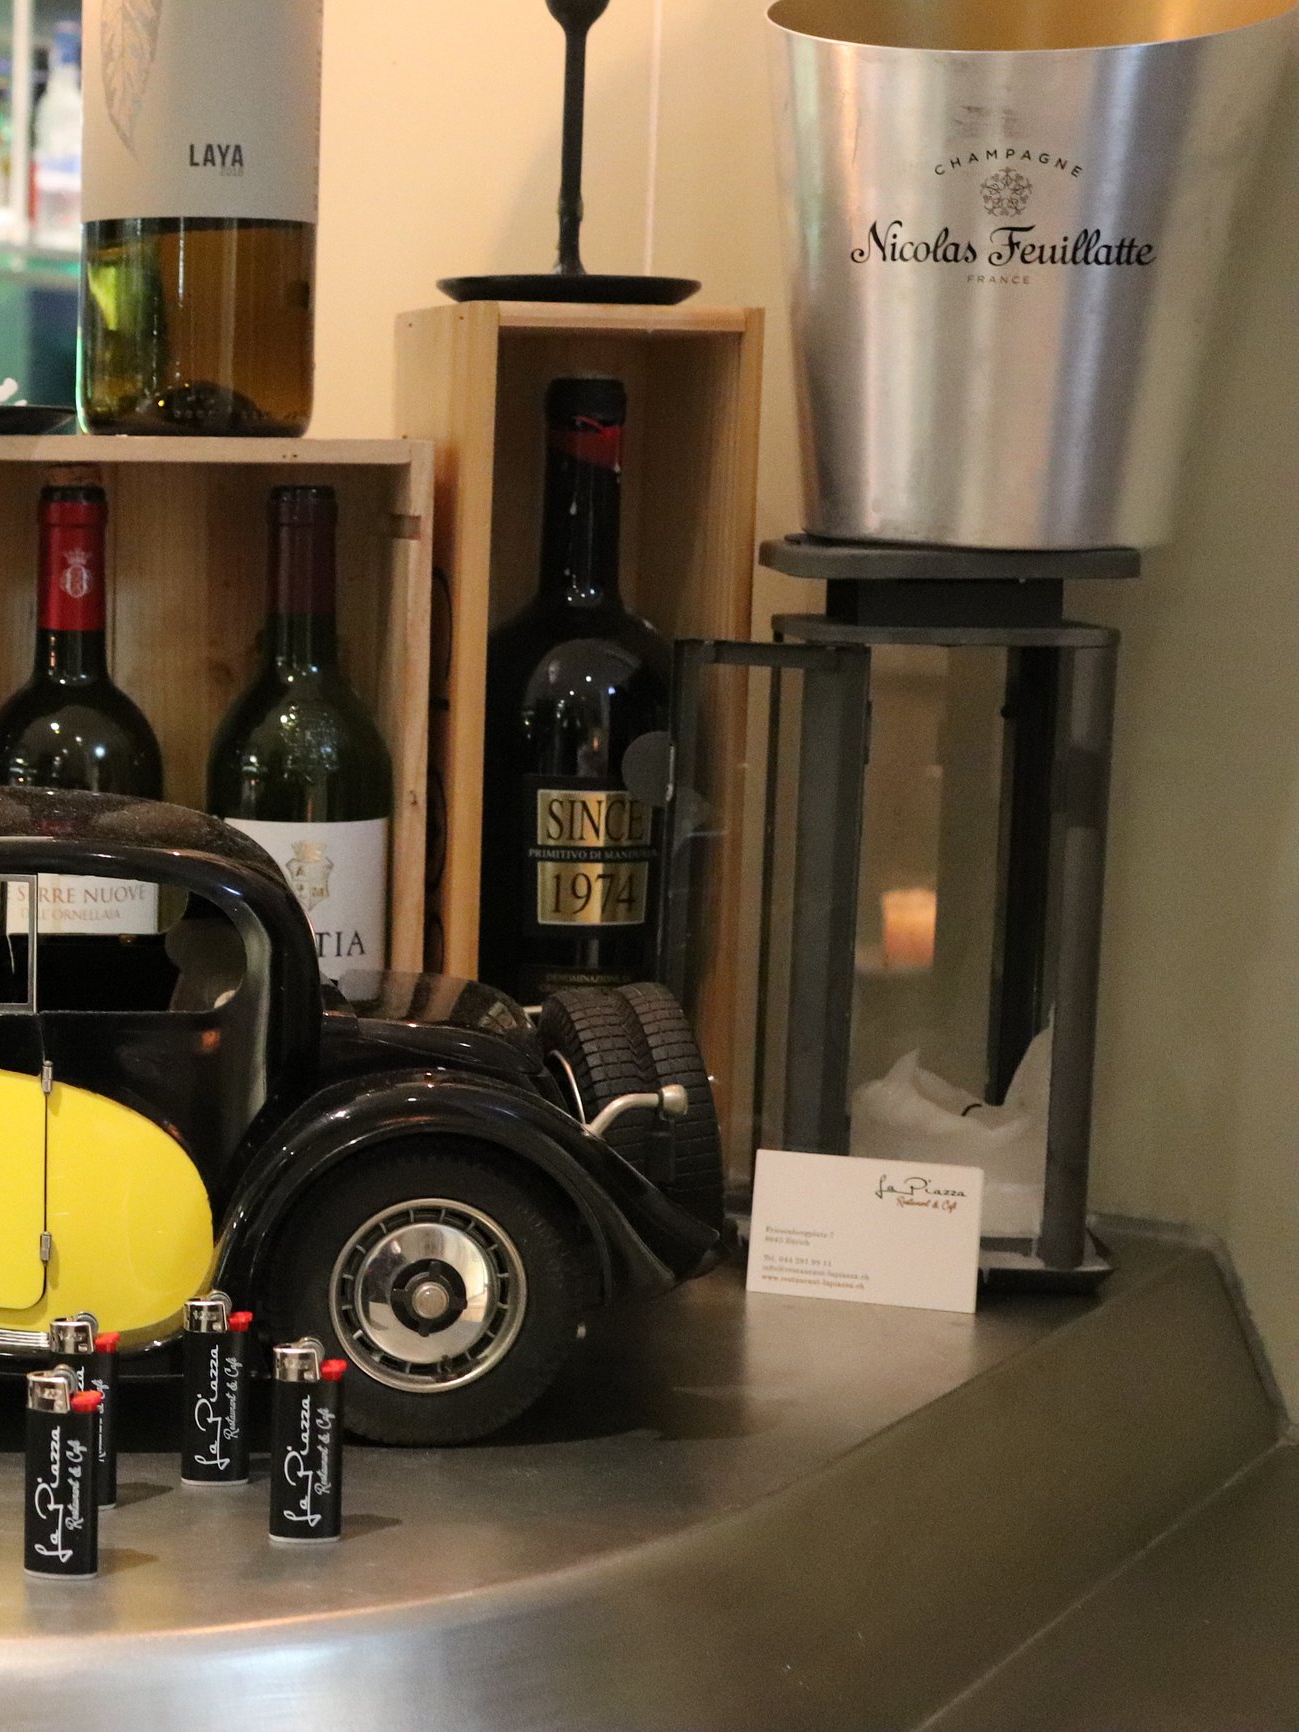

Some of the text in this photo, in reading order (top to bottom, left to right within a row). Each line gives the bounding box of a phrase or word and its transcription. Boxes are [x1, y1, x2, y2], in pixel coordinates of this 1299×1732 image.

[188, 144, 244, 168] LAYA
[934, 148, 1083, 178] CHAMPAGNE
[850, 219, 1157, 267] Nicolas Feuillatte
[966, 275, 1031, 285] FRANCE
[546, 798, 646, 842] SINCE
[528, 847, 588, 860] PRIMITIVO
[17, 886, 75, 904] SRRE
[83, 885, 146, 904] NUOVE
[552, 872, 637, 916] 1974
[903, 1176, 968, 1198] Piazza
[194, 1343, 222, 1432] Piazza
[223, 1392, 240, 1440] Restaurant
[283, 1394, 314, 1487] Piazza
[34, 1425, 64, 1520] Piazza
